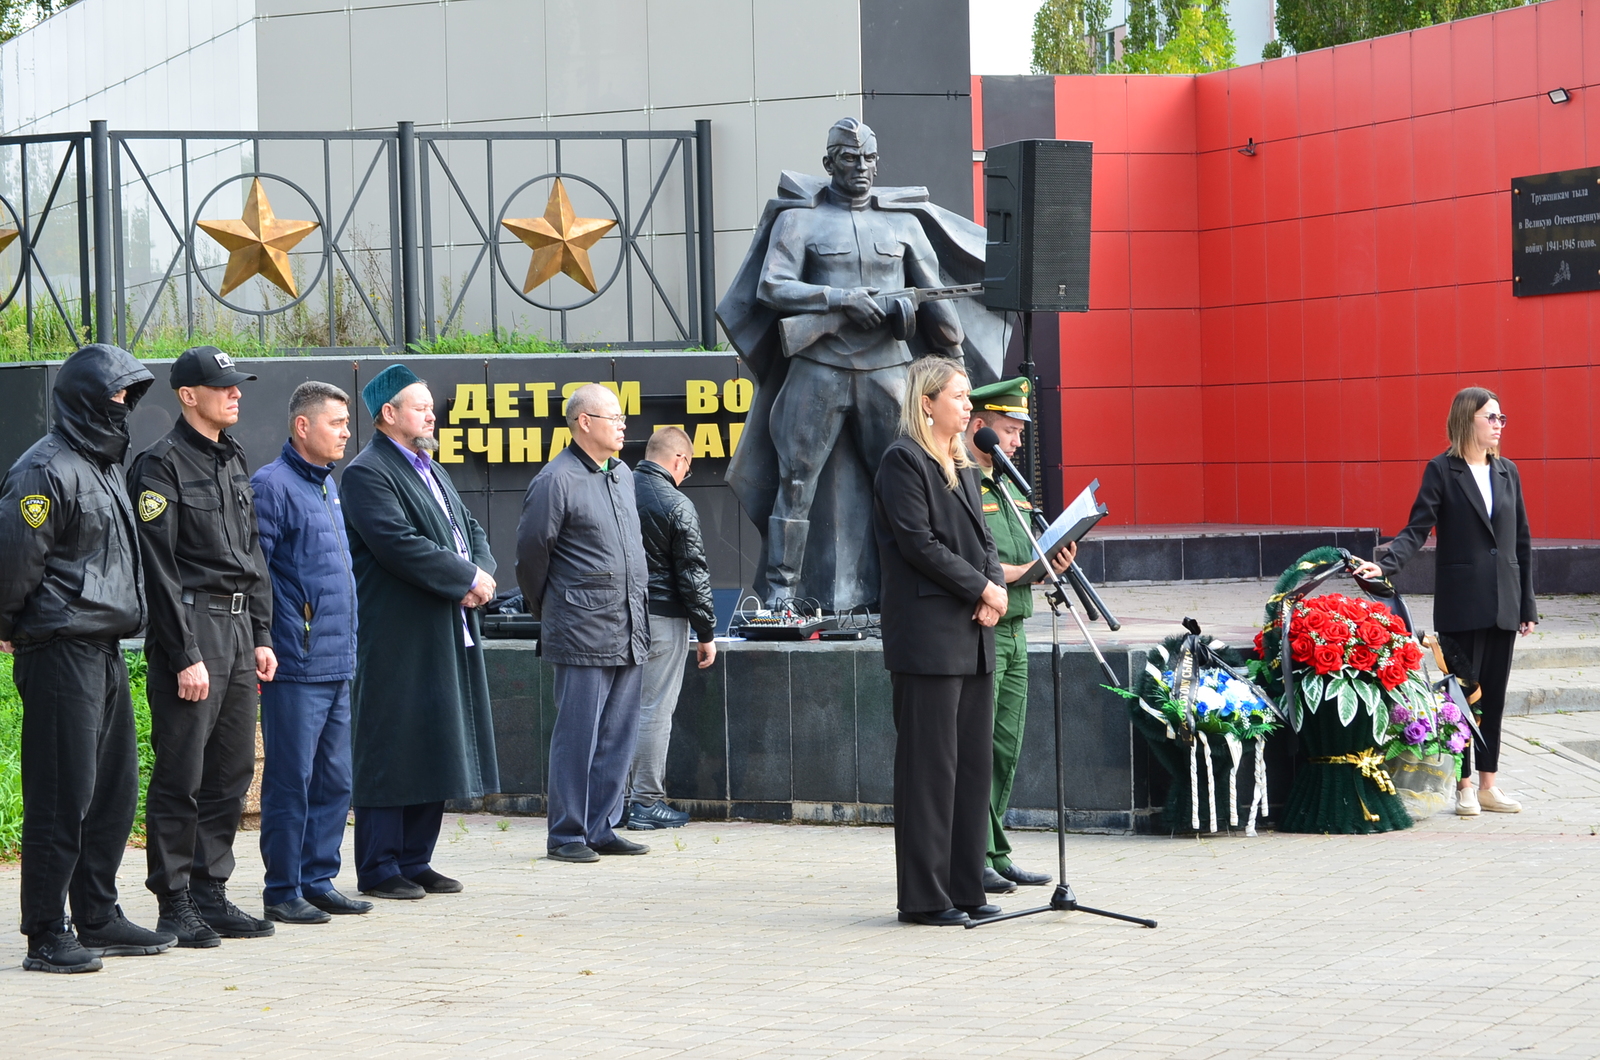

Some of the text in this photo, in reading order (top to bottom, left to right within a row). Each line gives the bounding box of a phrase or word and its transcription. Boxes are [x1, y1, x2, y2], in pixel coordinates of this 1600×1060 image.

[1531, 188, 1589, 205] Труженикам тыла
[1518, 221, 1523, 230] в
[1524, 218, 1552, 230] Великую
[1525, 238, 1597, 255] войну 1941-1945 годов.
[428, 427, 619, 463] ЕЧНА
